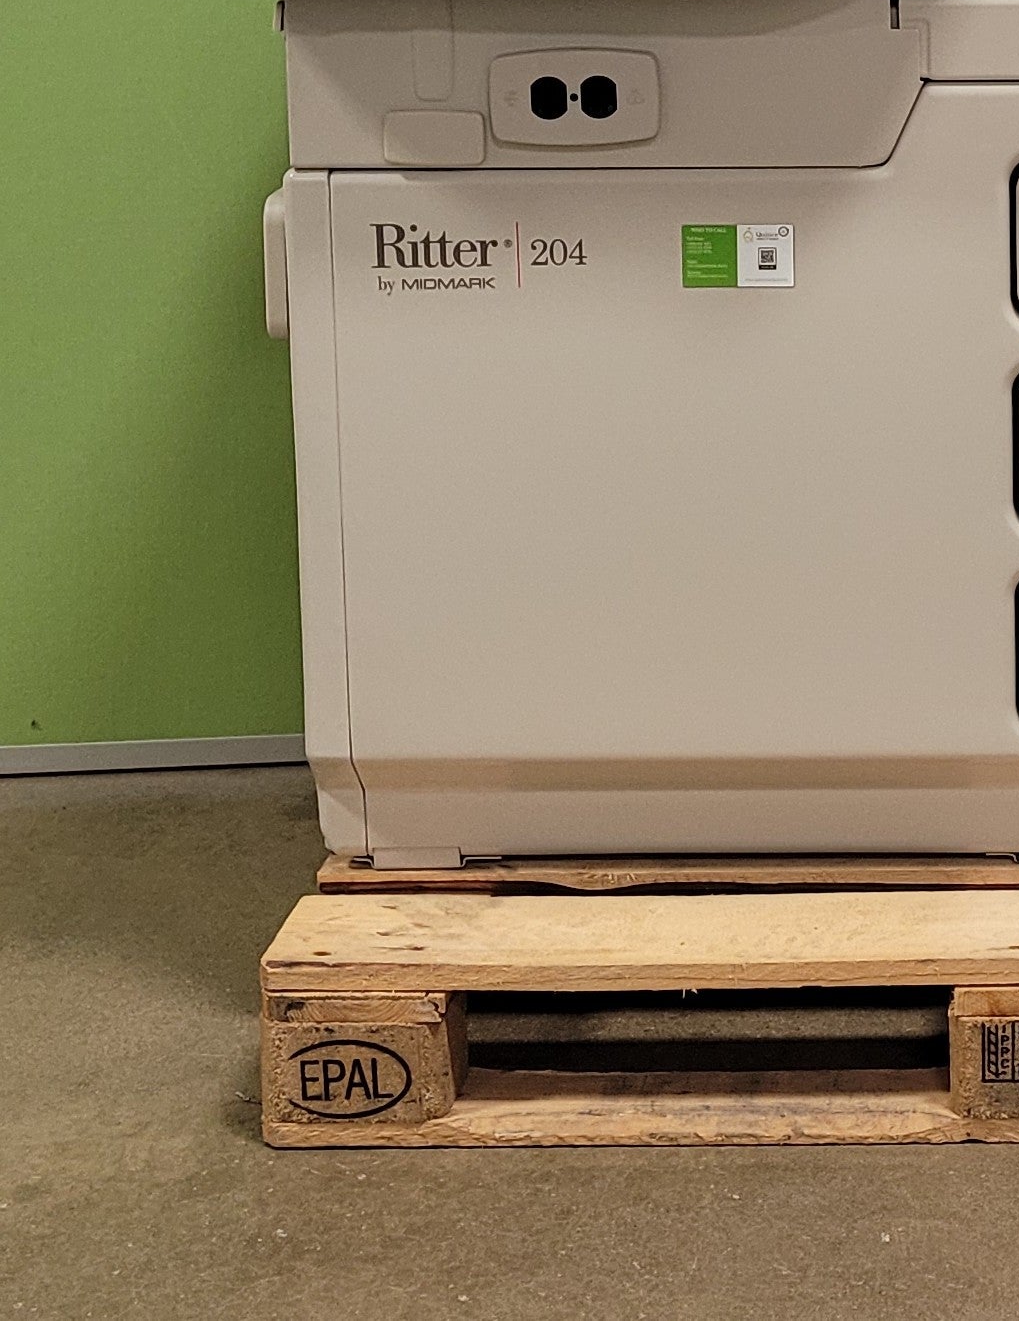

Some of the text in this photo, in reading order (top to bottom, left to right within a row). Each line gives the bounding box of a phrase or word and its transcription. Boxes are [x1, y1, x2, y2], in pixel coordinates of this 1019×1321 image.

[530, 238, 588, 266] 204
[378, 276, 496, 295] by MIDMARK
[300, 1057, 395, 1101] EPAL
